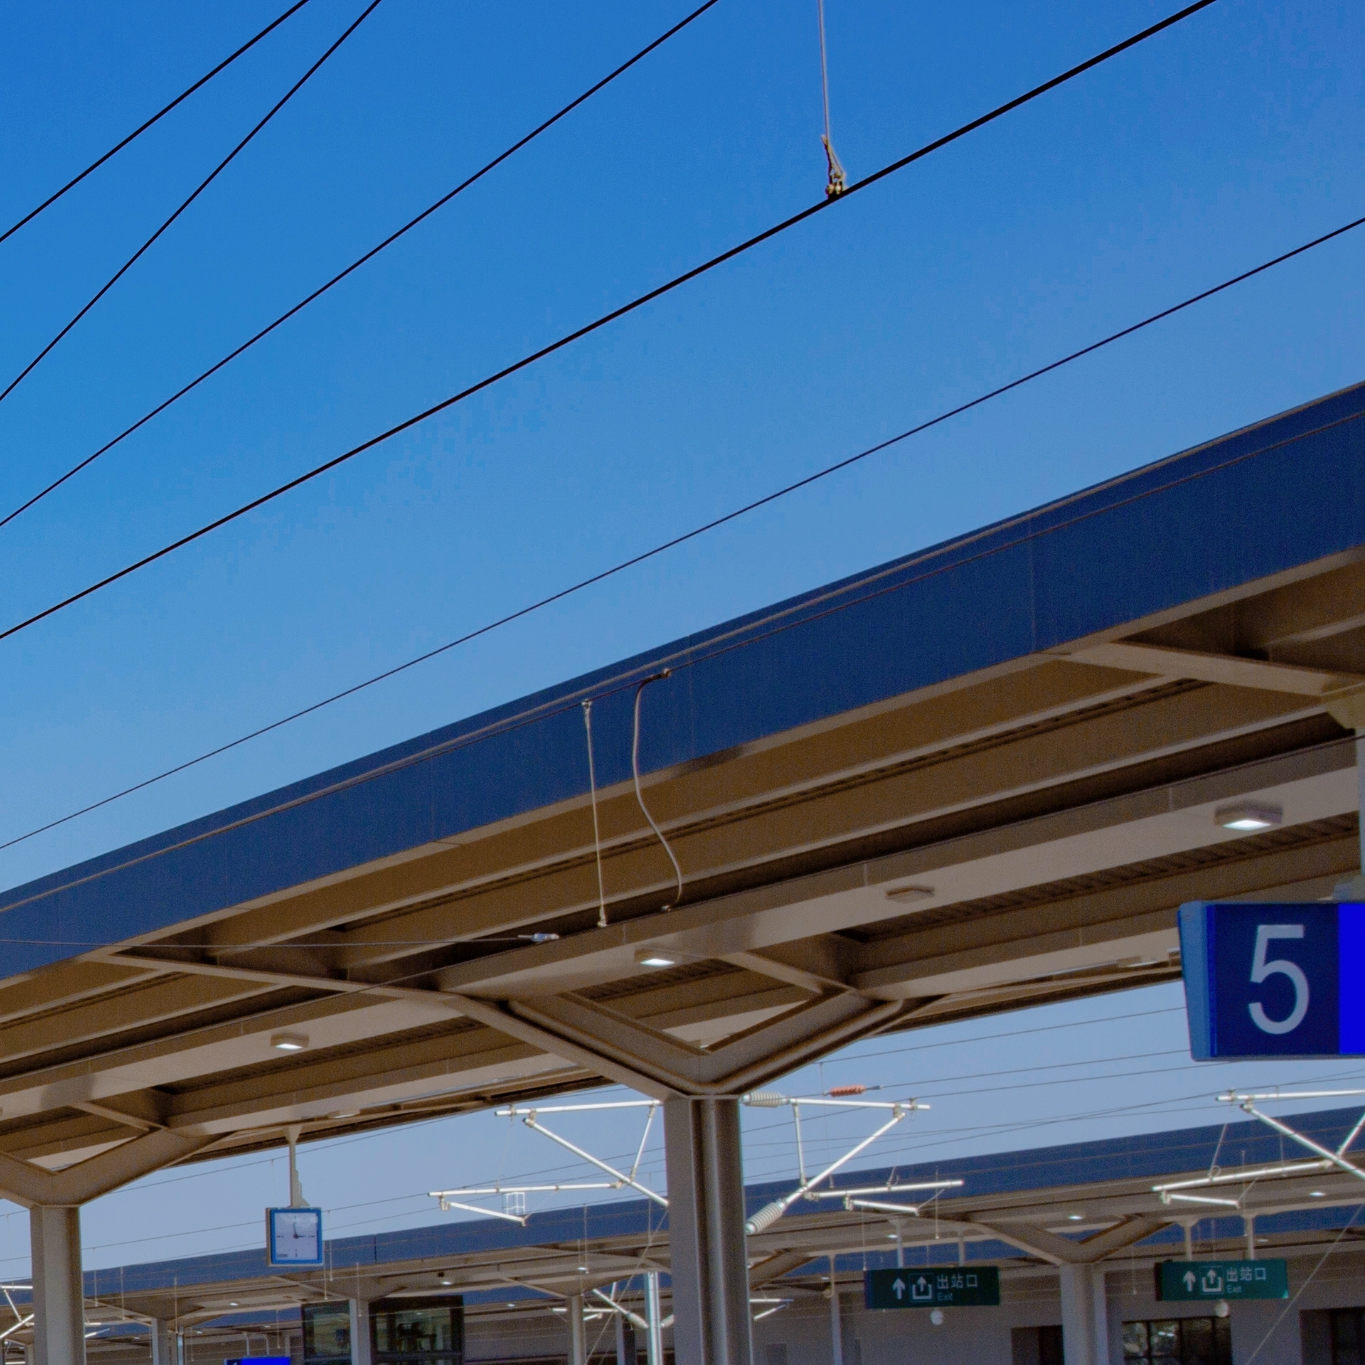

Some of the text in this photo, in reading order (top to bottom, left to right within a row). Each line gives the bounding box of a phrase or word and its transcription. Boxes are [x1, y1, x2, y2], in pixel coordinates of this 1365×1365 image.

[1247, 924, 1310, 1035] 5
[936, 1273, 978, 1290] 出站口
[1226, 1266, 1267, 1282] 出站口
[936, 1292, 953, 1301] Exit
[1226, 1284, 1242, 1294] Exit
